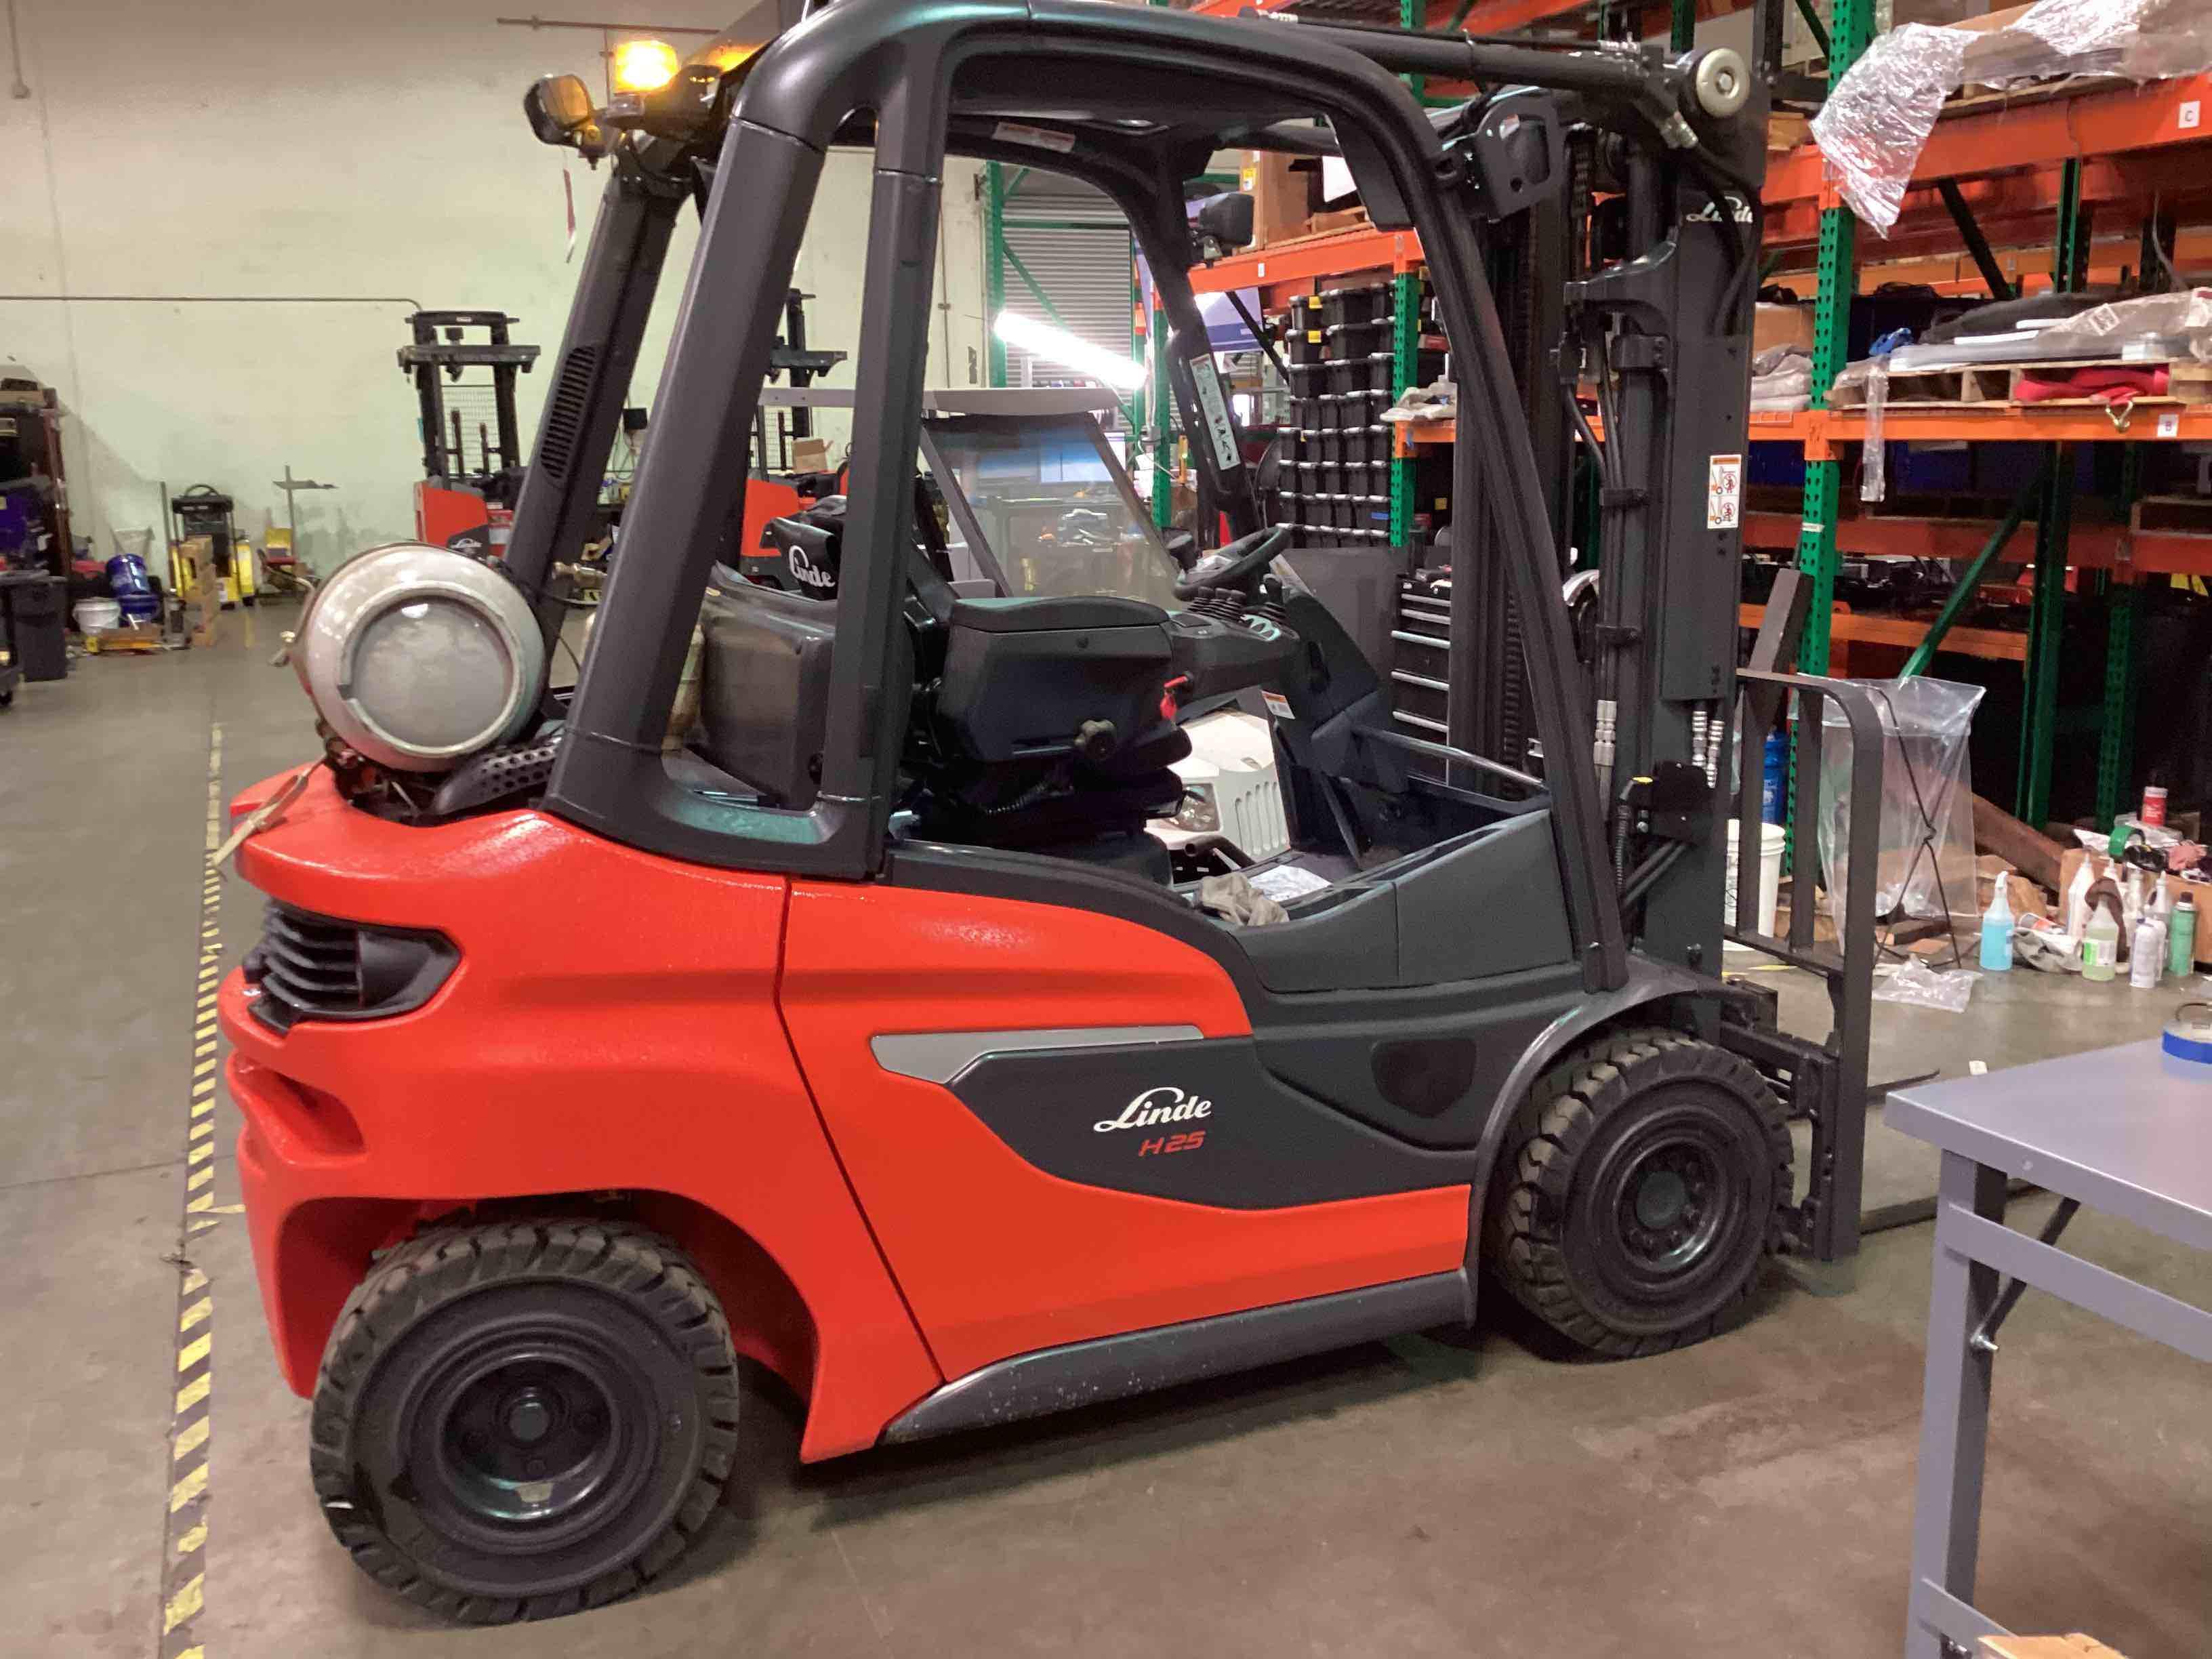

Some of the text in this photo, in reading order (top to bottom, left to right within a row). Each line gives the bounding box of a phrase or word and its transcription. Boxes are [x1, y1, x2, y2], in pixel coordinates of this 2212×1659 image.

[1685, 195, 1753, 224] Lid
[788, 544, 836, 588] Linde
[1092, 1086, 1212, 1132] Linde
